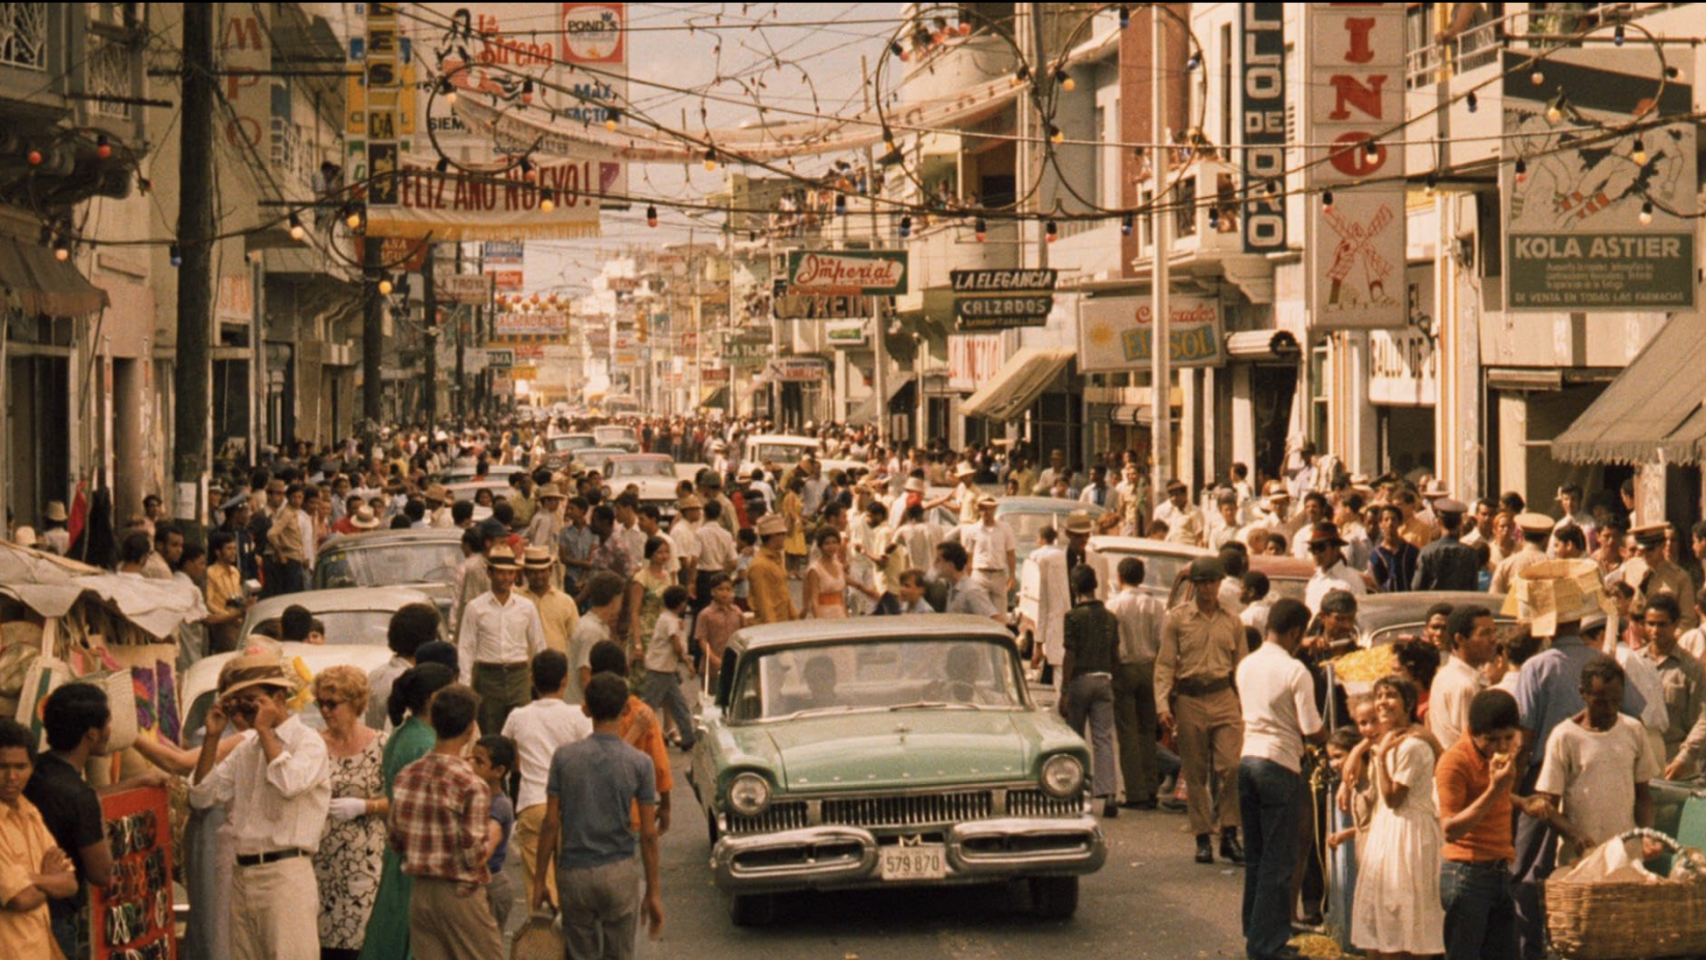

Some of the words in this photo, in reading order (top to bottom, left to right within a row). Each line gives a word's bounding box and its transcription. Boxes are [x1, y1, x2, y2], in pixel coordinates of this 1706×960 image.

[574, 83, 612, 99] MAX
[1328, 3, 1388, 177] INO
[564, 107, 620, 122] FACTO
[1245, 111, 1284, 133] DE
[429, 116, 471, 134] SIEM
[402, 164, 448, 210] ELIZ
[1247, 148, 1284, 246] ORO
[1515, 237, 1583, 259] KOLA
[1589, 237, 1681, 258] ASTIER
[797, 253, 894, 284] Imperial
[955, 272, 975, 289] LA
[976, 271, 1052, 288] ELEGANCIA
[1530, 292, 1561, 302] VENTA
[1565, 292, 1577, 302] EN
[1580, 292, 1611, 302] TODAS
[1613, 292, 1631, 301] LAS
[1635, 292, 1684, 301] FARMACIAS
[962, 299, 1047, 315] CALZADOS
[742, 344, 768, 356] TIJE
